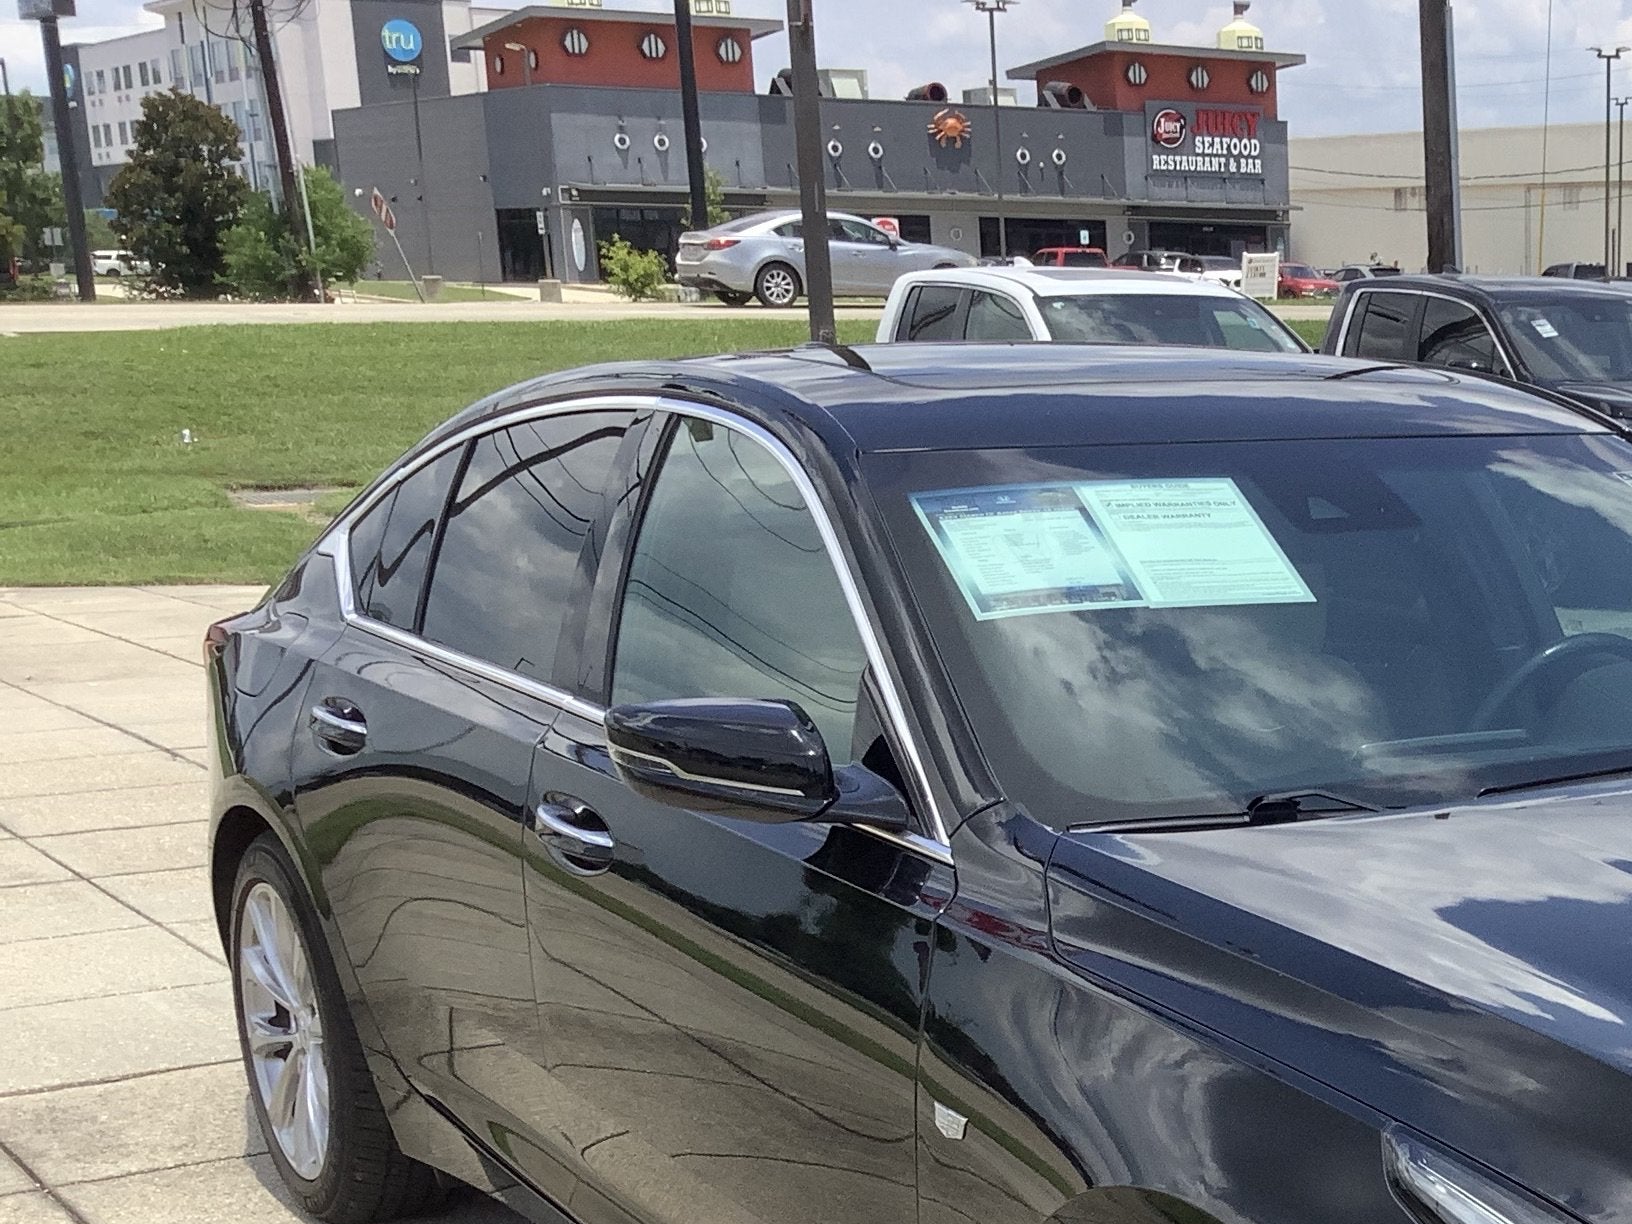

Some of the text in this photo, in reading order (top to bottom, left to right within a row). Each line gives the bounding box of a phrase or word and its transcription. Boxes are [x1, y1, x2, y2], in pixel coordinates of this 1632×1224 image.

[382, 30, 415, 50] tru
[1191, 109, 1260, 138] JUICY
[1195, 136, 1260, 156] SEAFOOD
[1152, 154, 1262, 174] RESTAURANT & BAR
